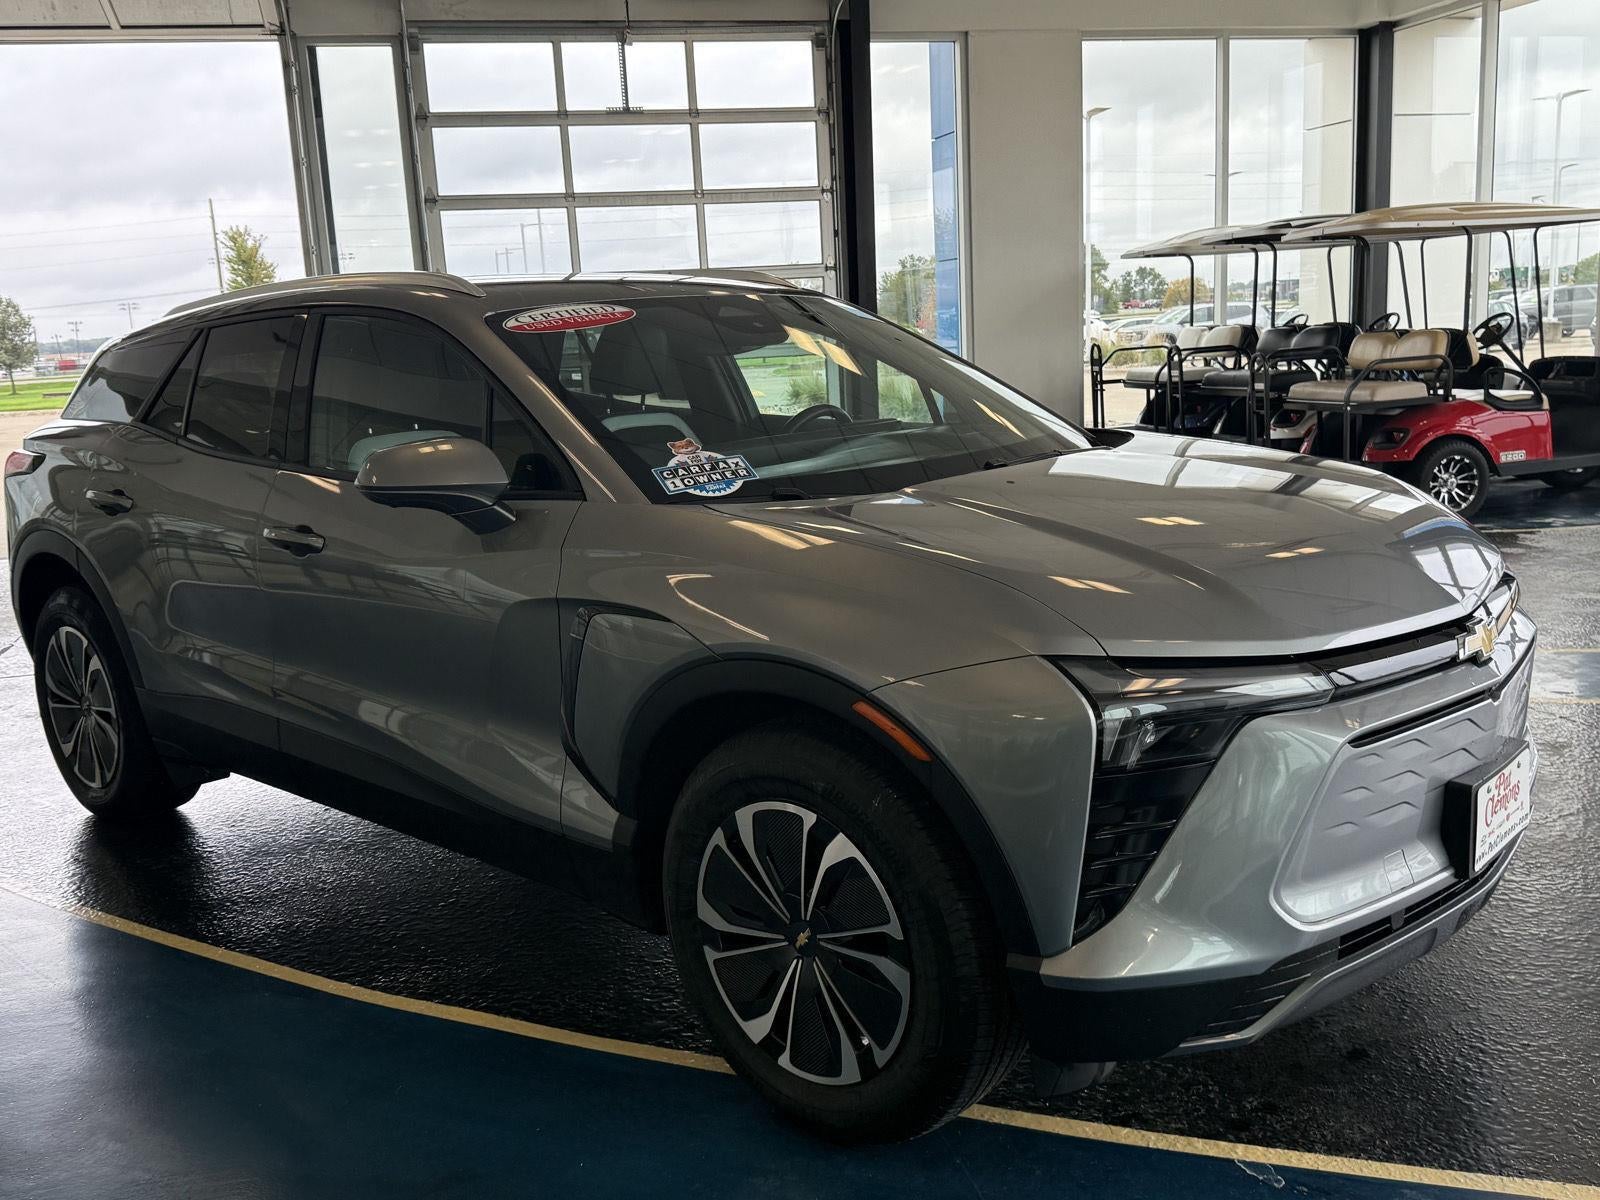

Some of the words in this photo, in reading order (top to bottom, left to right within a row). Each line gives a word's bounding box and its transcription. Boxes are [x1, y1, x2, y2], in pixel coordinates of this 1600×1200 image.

[514, 305, 616, 324] CERTIFIED
[523, 319, 562, 330] USED
[565, 311, 625, 324] VEHICLE
[662, 460, 743, 479] CARFAX
[670, 479, 681, 489] 1
[683, 468, 749, 486] OWNER
[1495, 770, 1511, 797] Pat
[1485, 780, 1520, 828] Clemons
